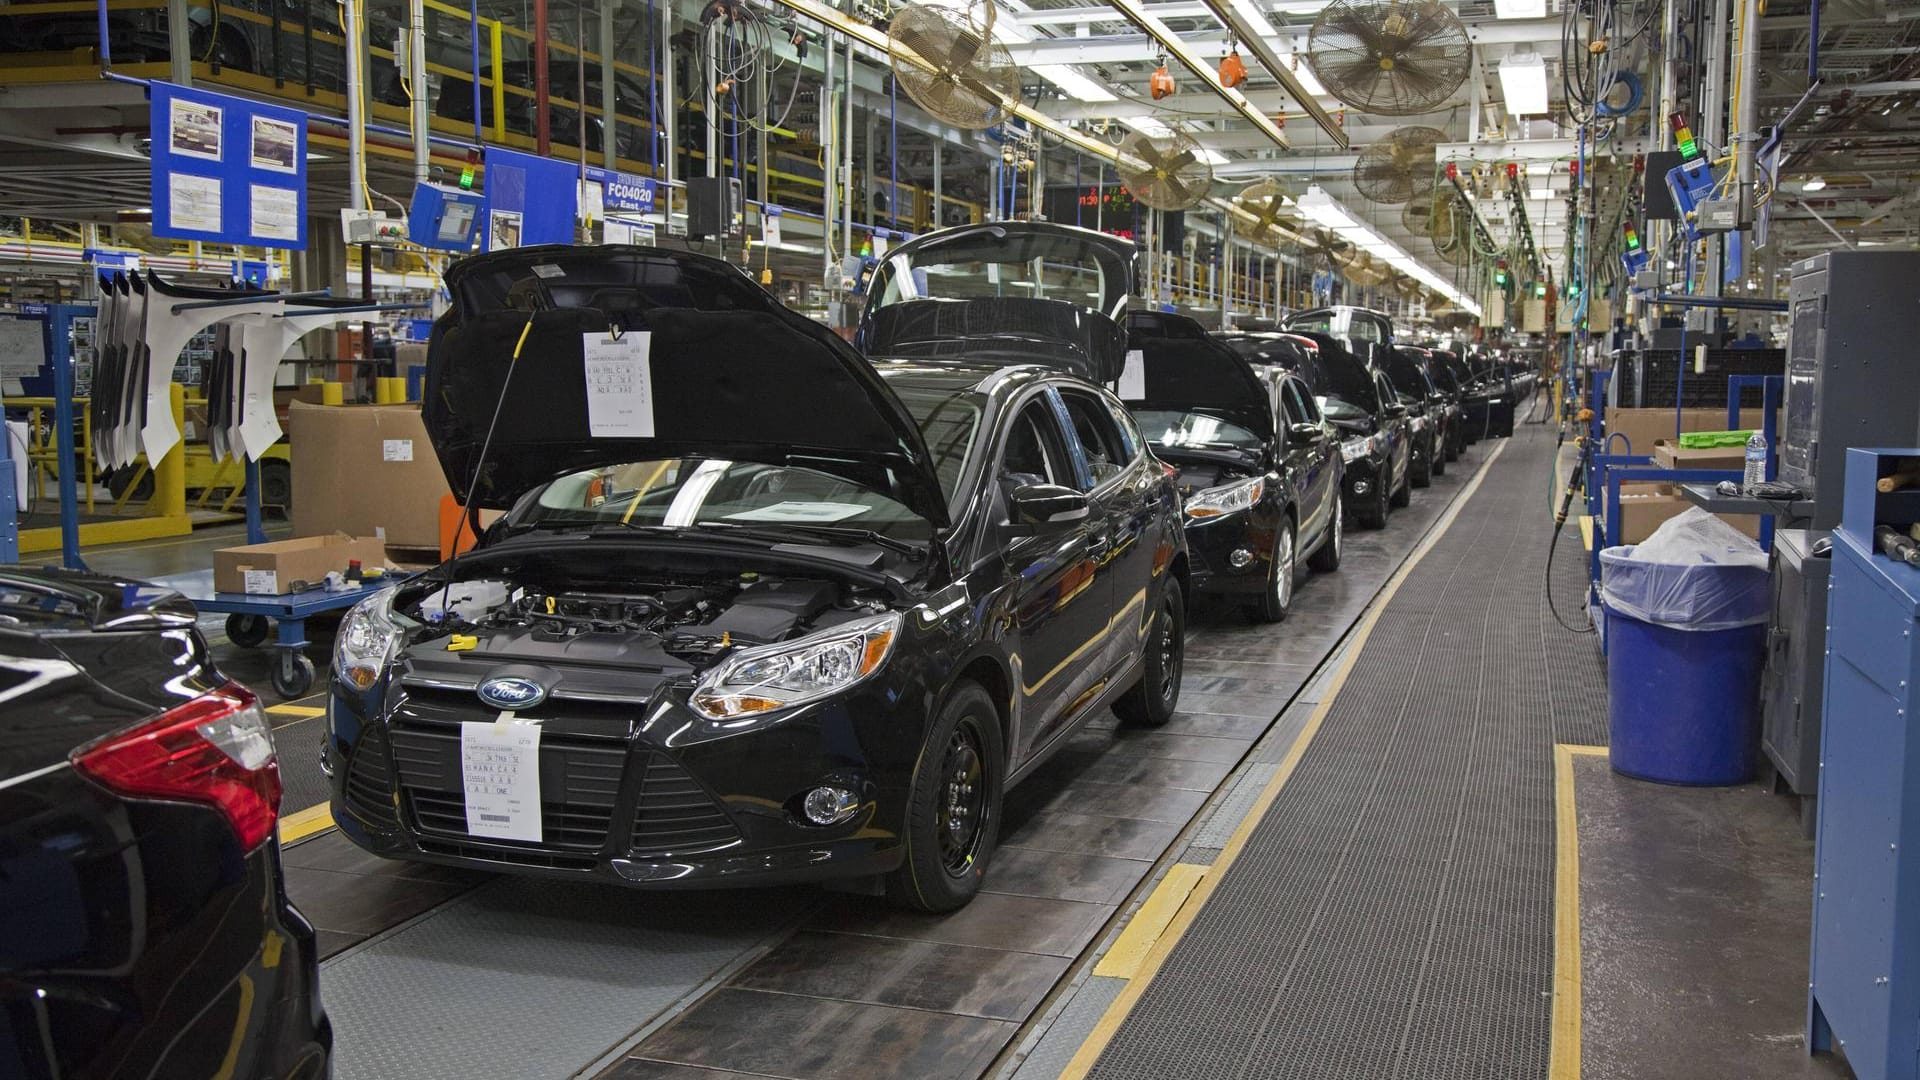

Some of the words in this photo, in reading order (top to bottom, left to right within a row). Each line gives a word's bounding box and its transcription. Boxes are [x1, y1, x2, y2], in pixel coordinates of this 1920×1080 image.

[608, 183, 651, 202] FC04020
[620, 199, 639, 210] East
[492, 682, 527, 702] Ford
